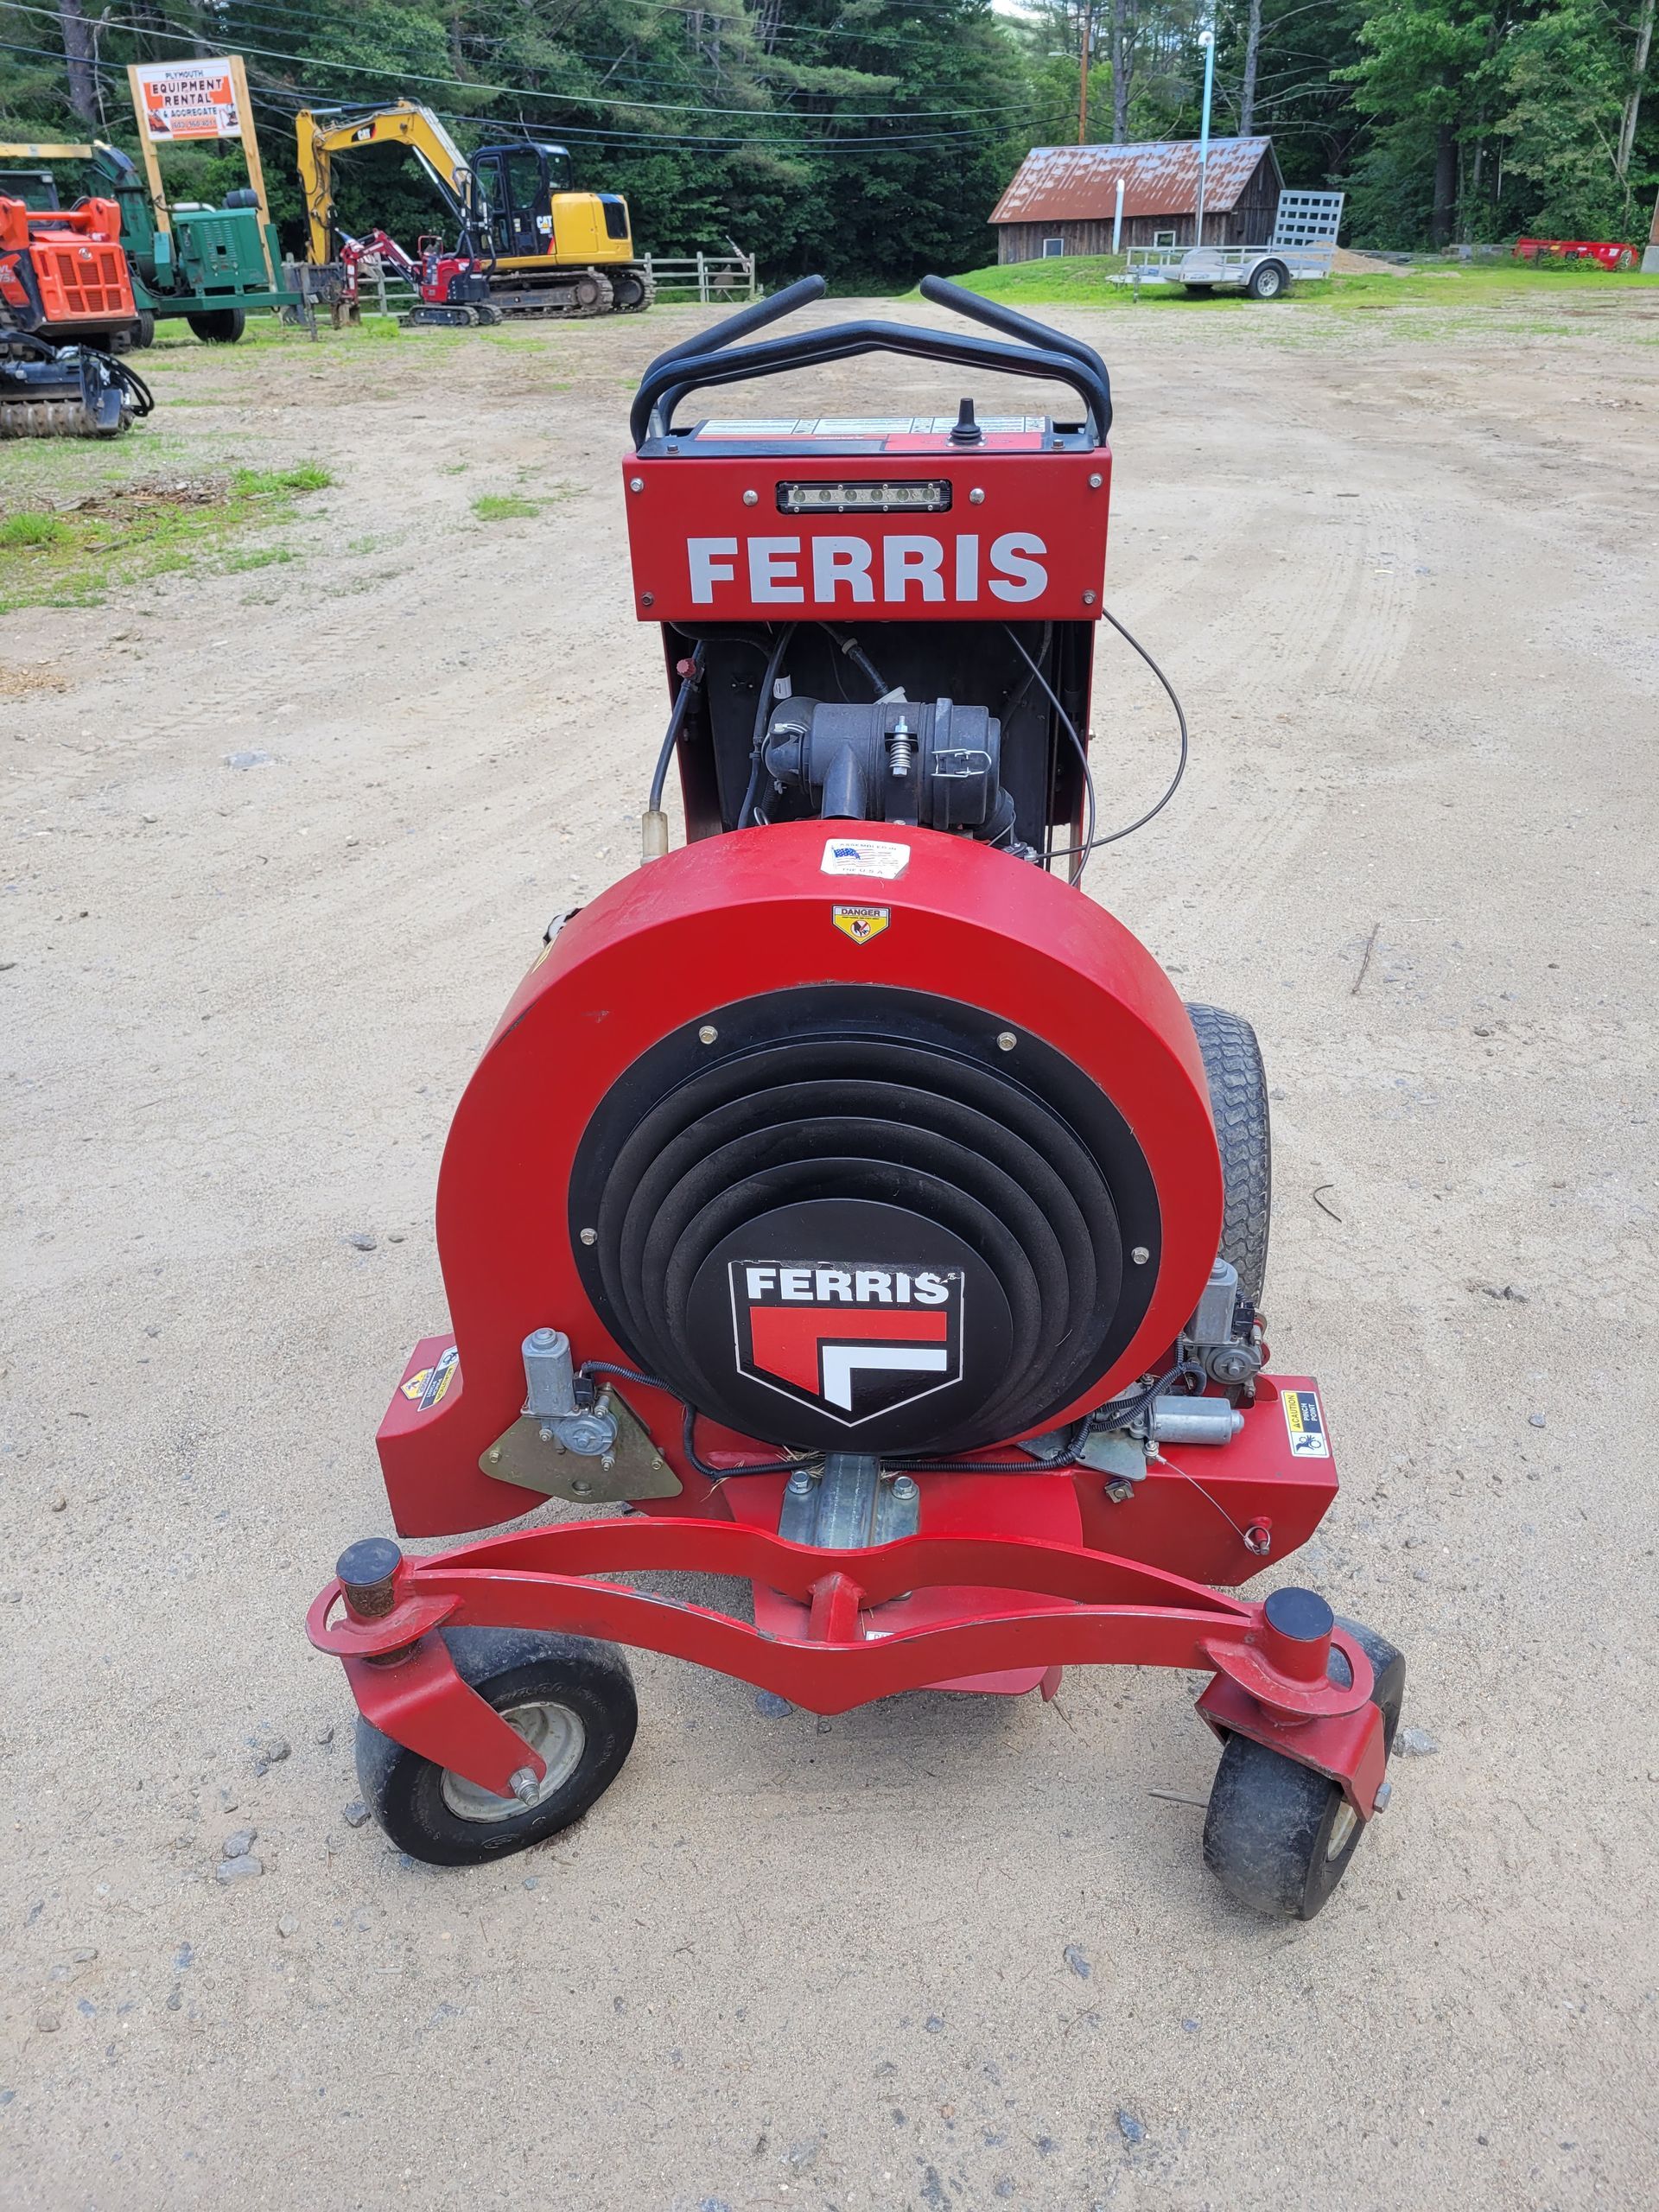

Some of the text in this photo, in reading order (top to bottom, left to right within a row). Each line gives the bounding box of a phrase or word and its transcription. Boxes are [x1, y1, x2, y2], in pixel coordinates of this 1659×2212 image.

[165, 69, 204, 79] PLYMOUTH
[152, 79, 222, 94] EQUIPMENT
[165, 93, 212, 105] RENTAL
[357, 128, 371, 141] CAT
[536, 215, 552, 229] CAT
[687, 531, 1048, 604] FERRIS
[841, 908, 880, 917] DANGER
[746, 1268, 949, 1305] FERRIS
[1287, 1395, 1300, 1424] CAUTION
[1300, 1402, 1310, 1421] PINCH
[1308, 1403, 1318, 1421] POINT
